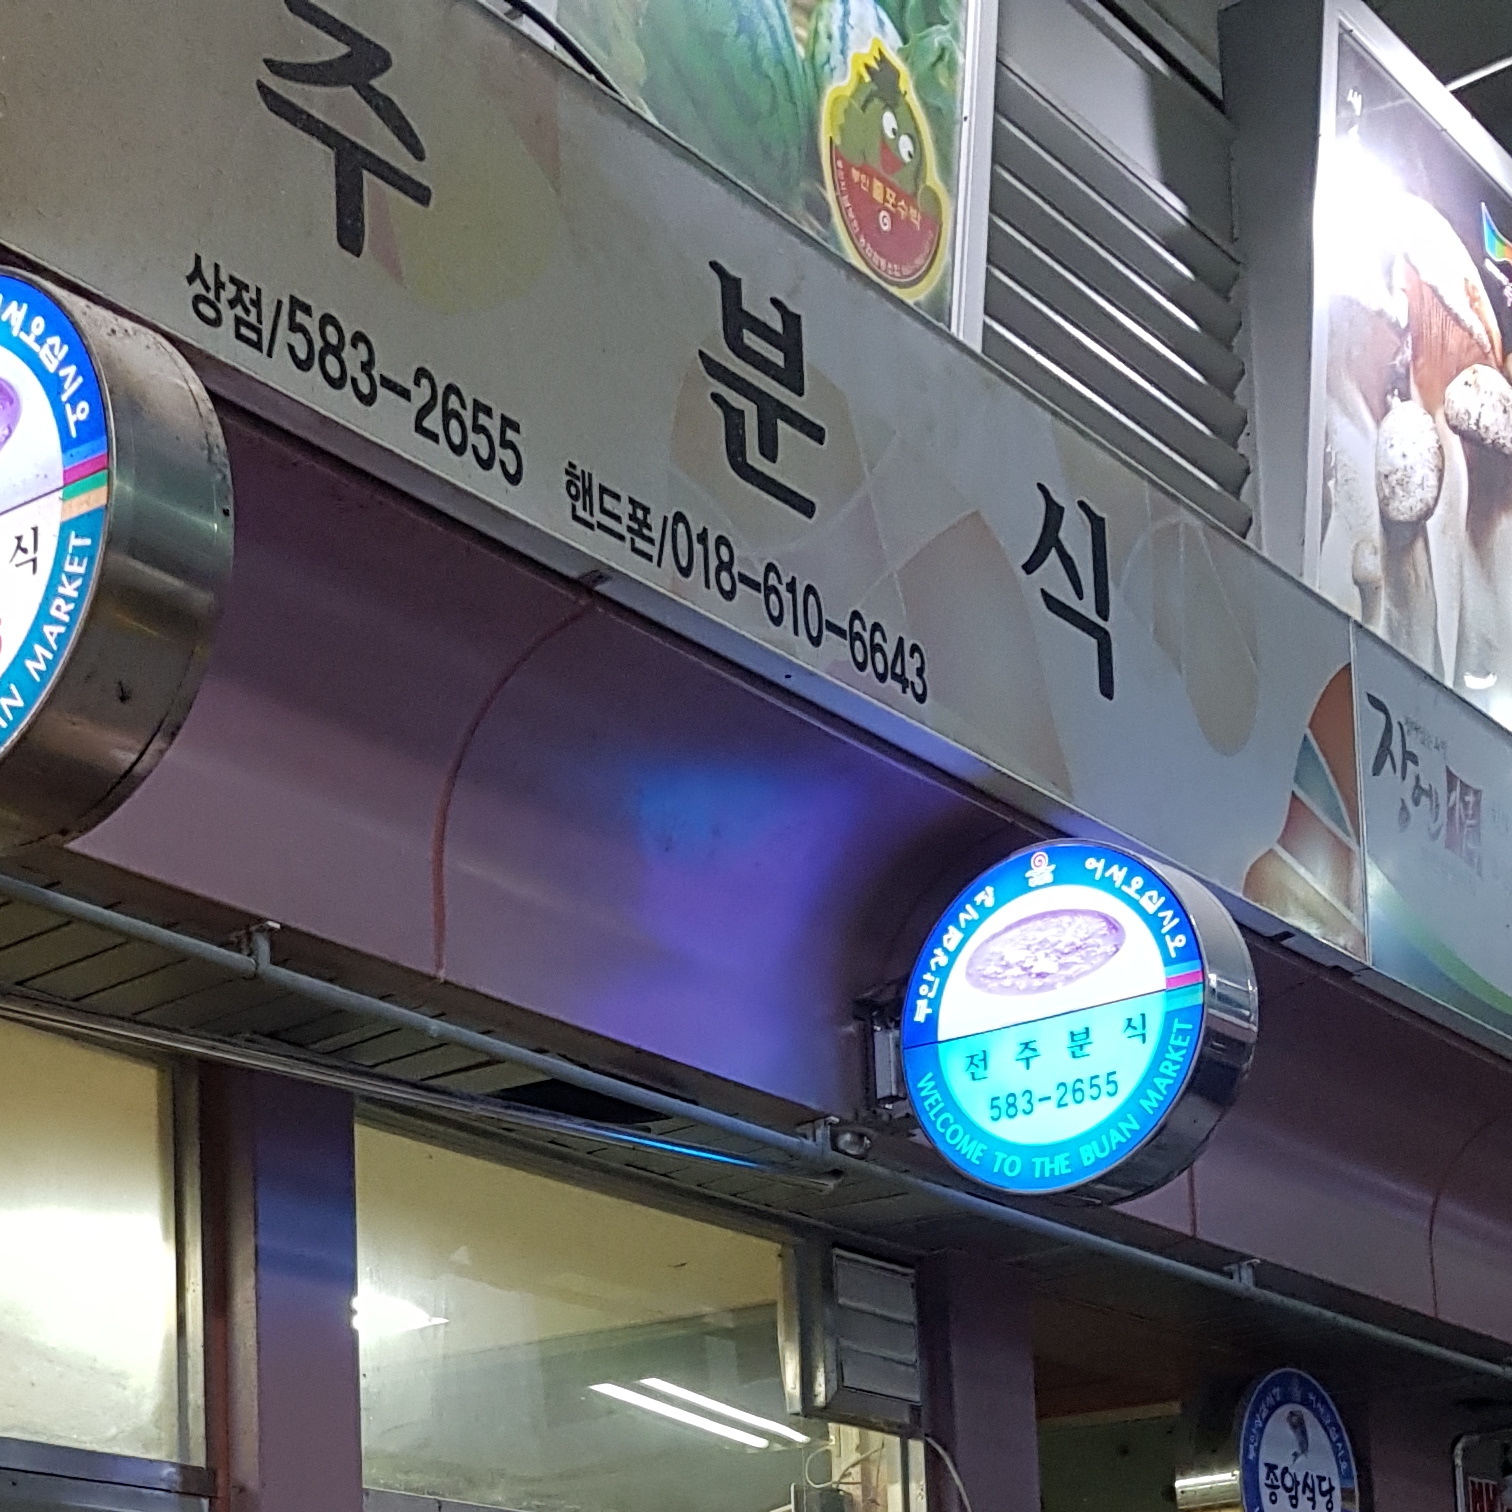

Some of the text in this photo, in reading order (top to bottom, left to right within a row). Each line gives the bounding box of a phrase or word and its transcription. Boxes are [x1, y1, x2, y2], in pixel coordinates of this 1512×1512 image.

[698, 260, 826, 519] 분
[1022, 482, 1115, 700] 식
[25, 531, 93, 682] MARKET
[1085, 857, 1186, 958] 어서오십시오
[917, 1018, 1193, 1178] WELCOME TO THE BUAN MARKET
[989, 1071, 1119, 1121] 583-2655
